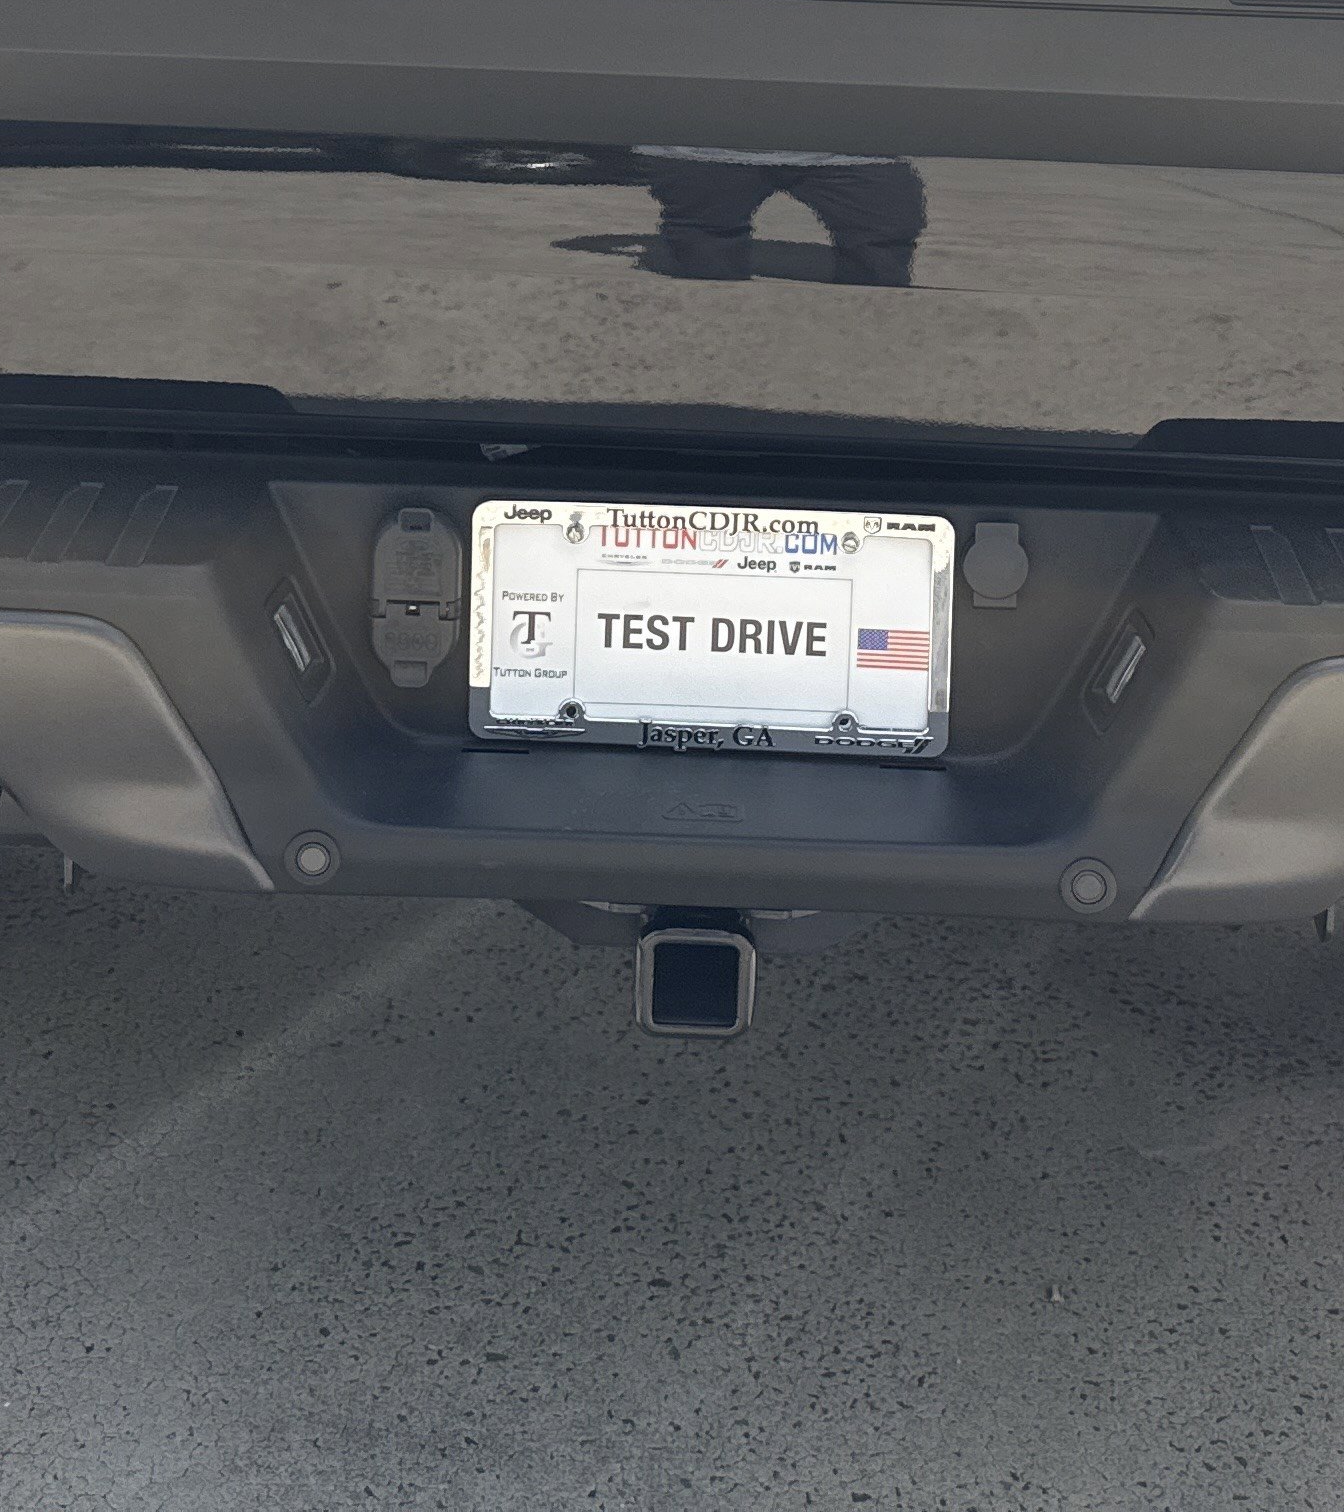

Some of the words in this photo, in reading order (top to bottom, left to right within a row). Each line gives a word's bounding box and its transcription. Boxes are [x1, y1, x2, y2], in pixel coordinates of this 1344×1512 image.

[504, 504, 552, 523] Jeep
[607, 508, 819, 536] TuttonCDJR.com
[737, 556, 777, 573] Jeep
[597, 613, 695, 651] TEST
[710, 617, 827, 657] DRIVE
[637, 719, 724, 751] Jasper,
[733, 725, 776, 748] GA
